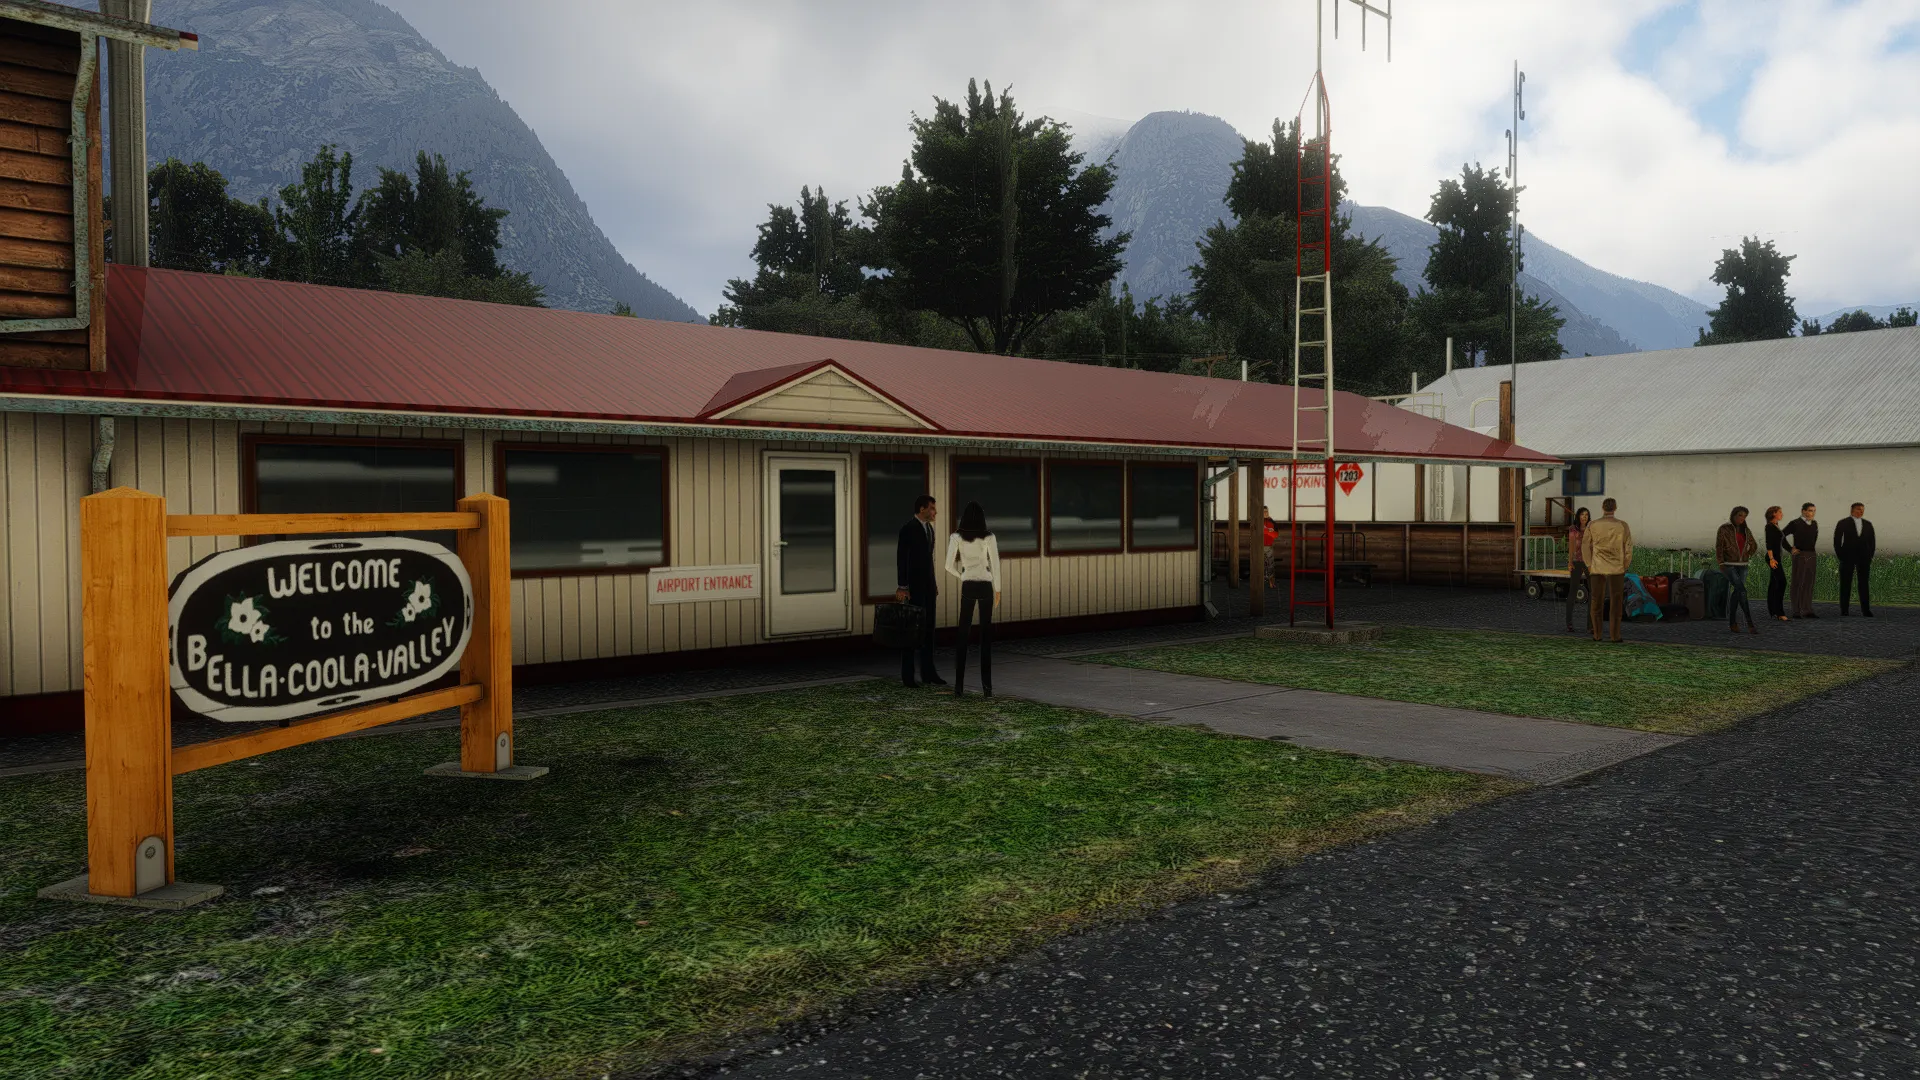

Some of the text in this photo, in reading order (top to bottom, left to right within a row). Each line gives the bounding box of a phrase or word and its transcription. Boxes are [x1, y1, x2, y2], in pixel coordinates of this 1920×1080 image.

[1263, 476, 1327, 489] NO SOKIN
[1340, 470, 1359, 482] 1203
[267, 558, 401, 599] WELCOME
[656, 574, 754, 593] AIRPORT ENTRANCE
[310, 612, 375, 640] to the
